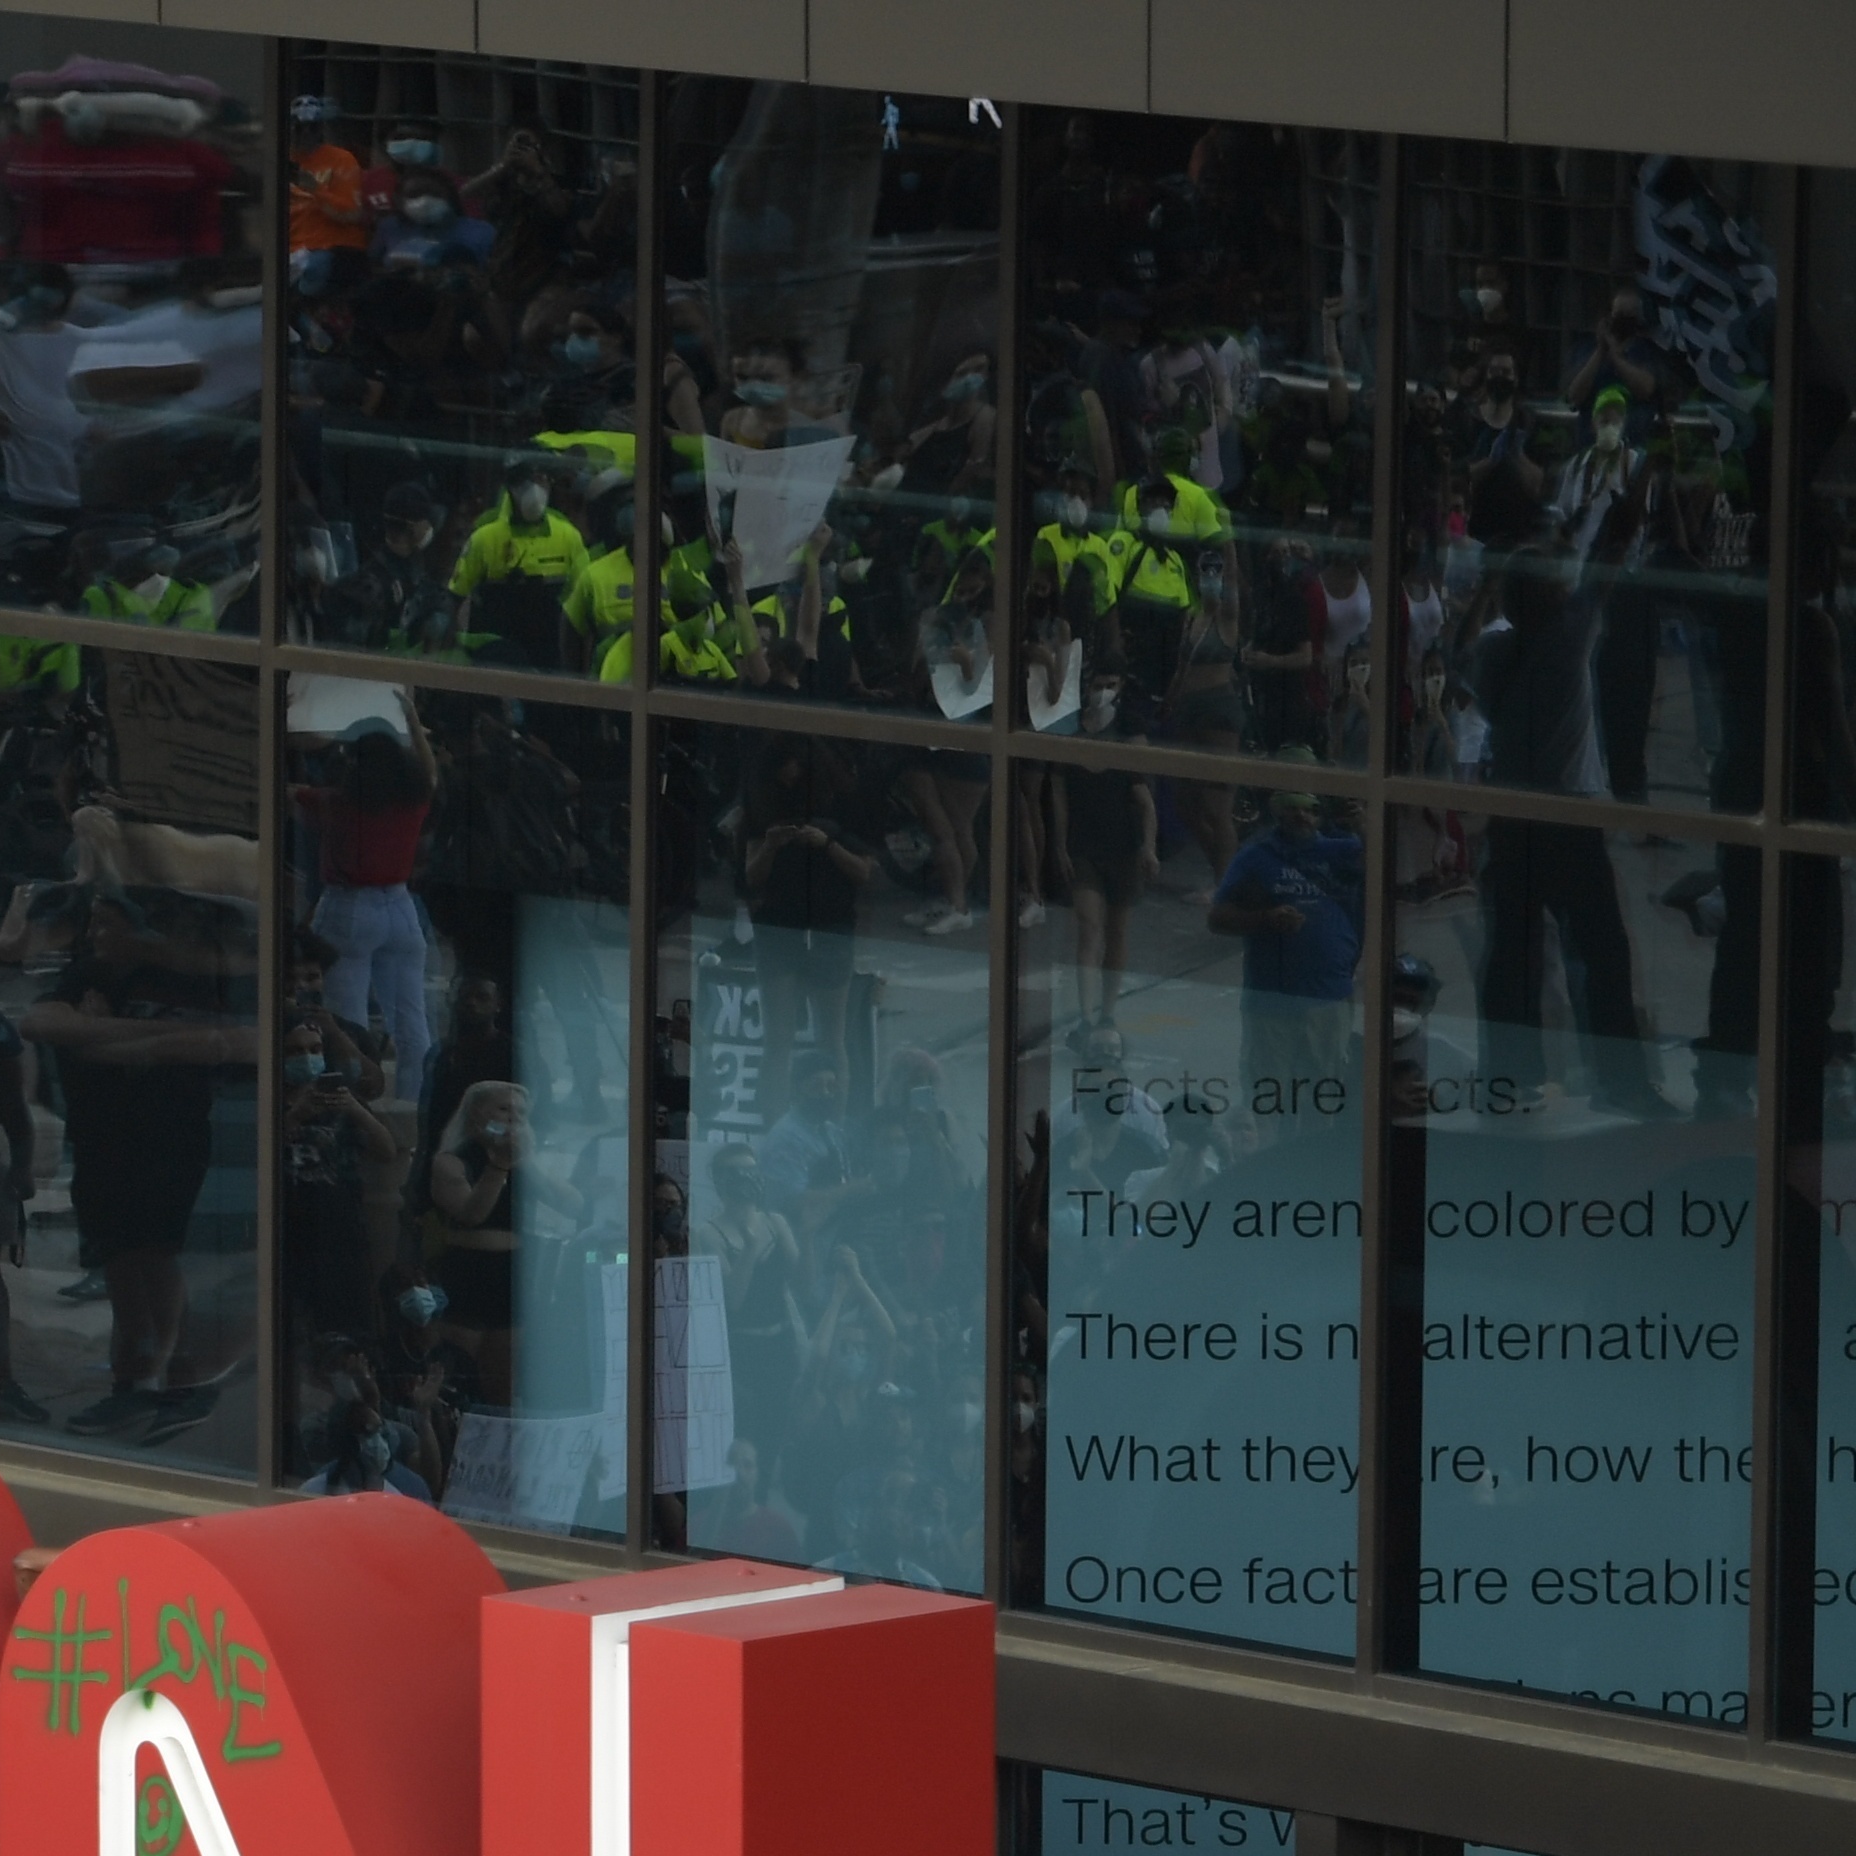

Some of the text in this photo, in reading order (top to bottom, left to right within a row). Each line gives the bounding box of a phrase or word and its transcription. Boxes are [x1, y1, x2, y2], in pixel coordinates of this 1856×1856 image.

[1071, 1066, 1533, 1117] Facts are cts.
[1065, 1190, 1746, 1249] They aren colored by
[1065, 1313, 1237, 1362] There
[1260, 1313, 1303, 1362] is
[1422, 1312, 1740, 1362] alternative
[1065, 1435, 1752, 1495] What they re, how the
[1064, 1556, 1508, 1605] Once fact are
[1063, 1798, 1248, 1847] That's
